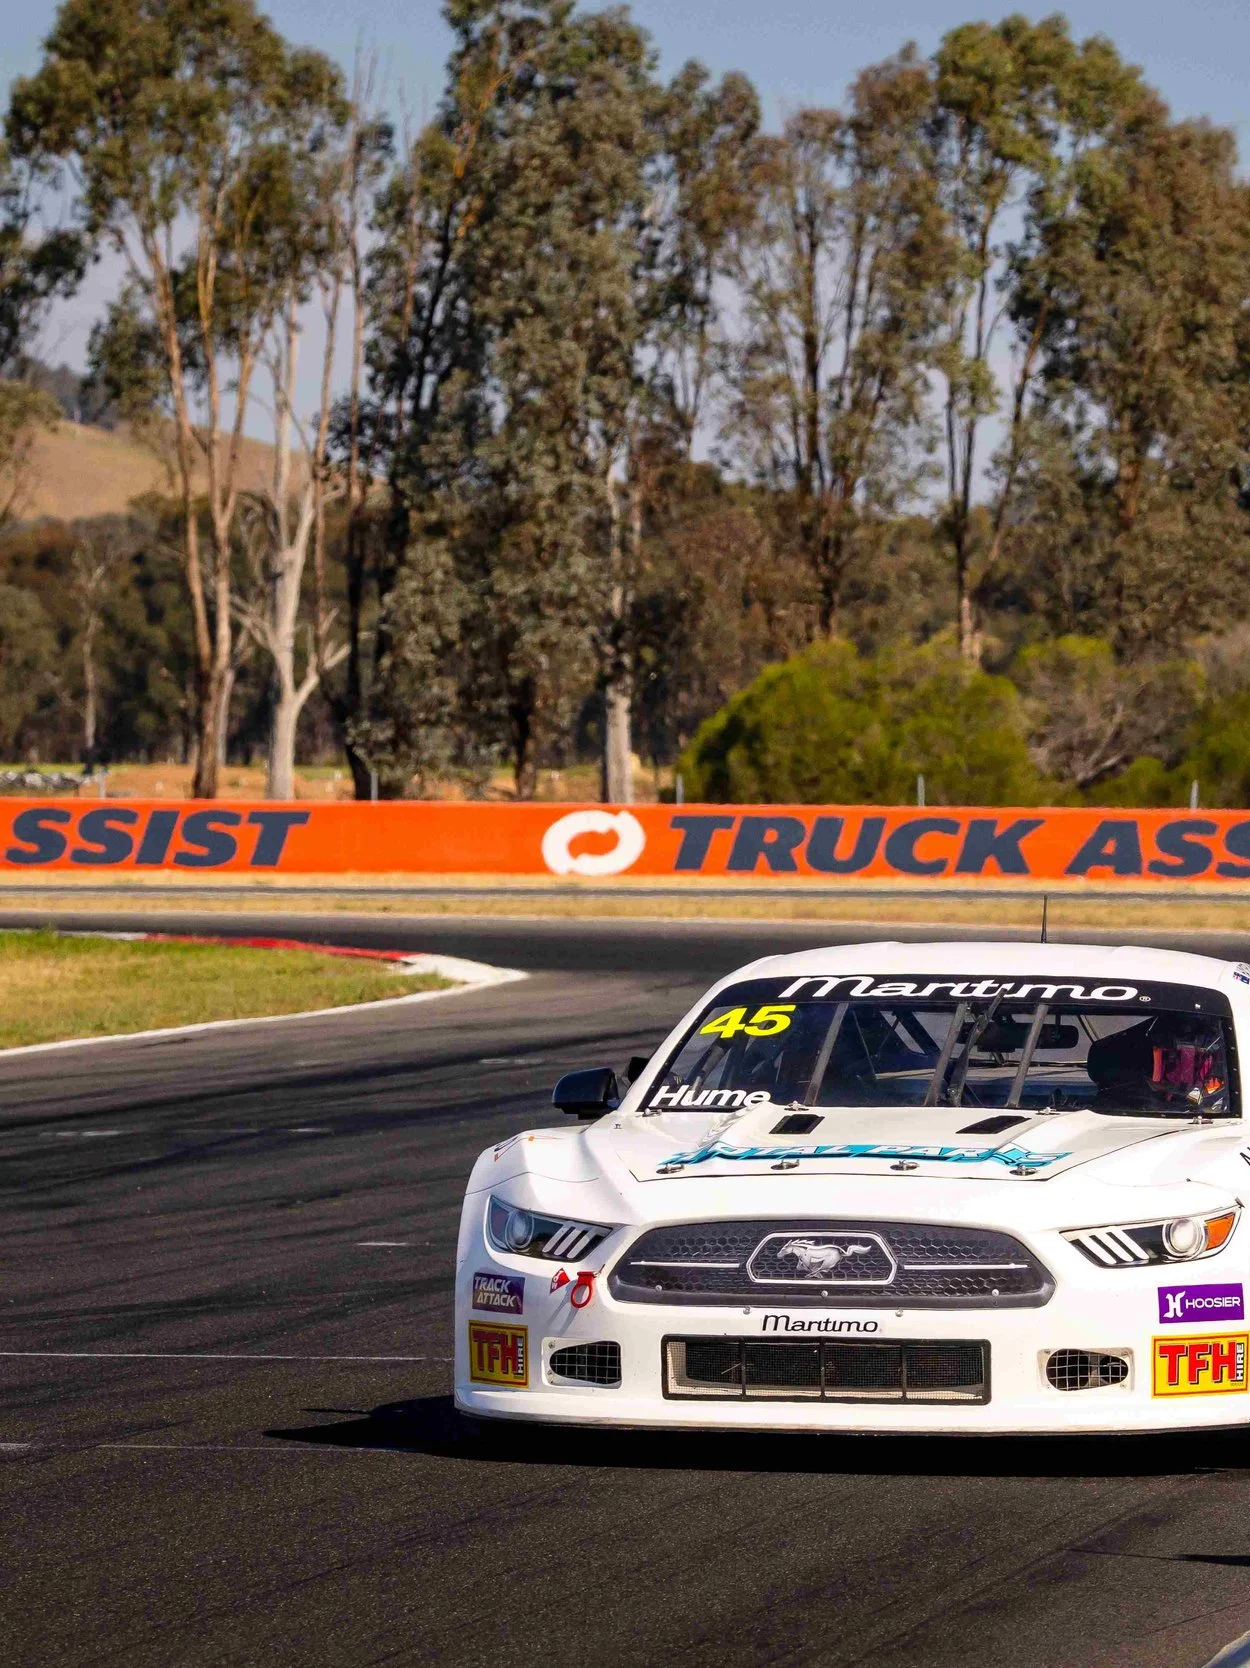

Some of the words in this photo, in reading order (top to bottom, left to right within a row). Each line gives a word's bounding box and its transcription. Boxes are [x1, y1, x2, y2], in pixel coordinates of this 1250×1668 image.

[669, 814, 1044, 875] TRUCK
[778, 975, 1140, 999] Maritimo
[700, 1005, 796, 1038] 45
[649, 1085, 771, 1108] Hume
[474, 1276, 512, 1293] TRACK
[476, 1292, 516, 1307] ATTACK
[1185, 1297, 1241, 1309] HOOSIER
[762, 1314, 879, 1332] Maritimo
[472, 1329, 519, 1375] TFH
[1159, 1341, 1236, 1386] TFH
[1236, 1342, 1244, 1381] HIRE
